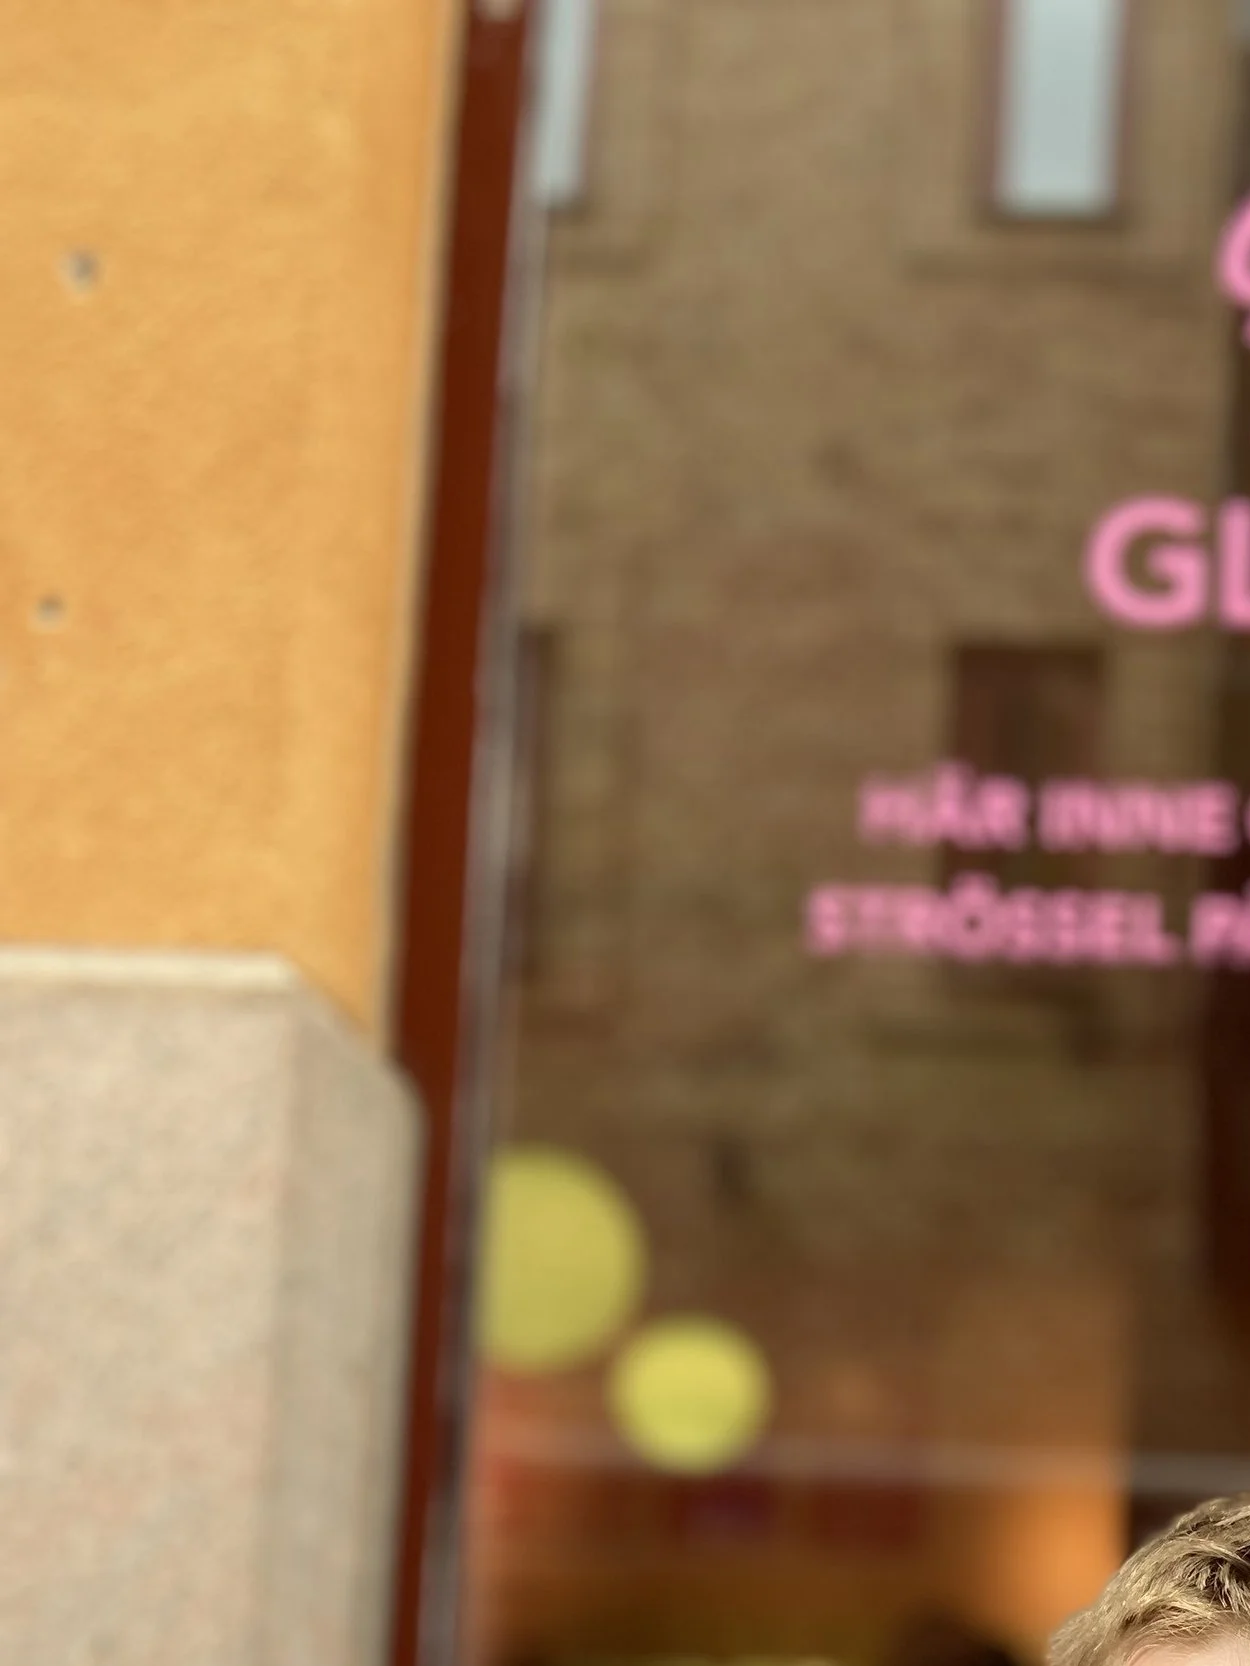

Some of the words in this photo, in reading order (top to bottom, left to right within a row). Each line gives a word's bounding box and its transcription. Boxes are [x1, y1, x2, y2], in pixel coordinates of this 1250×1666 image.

[860, 764, 1026, 847] HÄR
[1041, 779, 1235, 854] INNE
[809, 873, 1177, 963] STRÖSSEL
